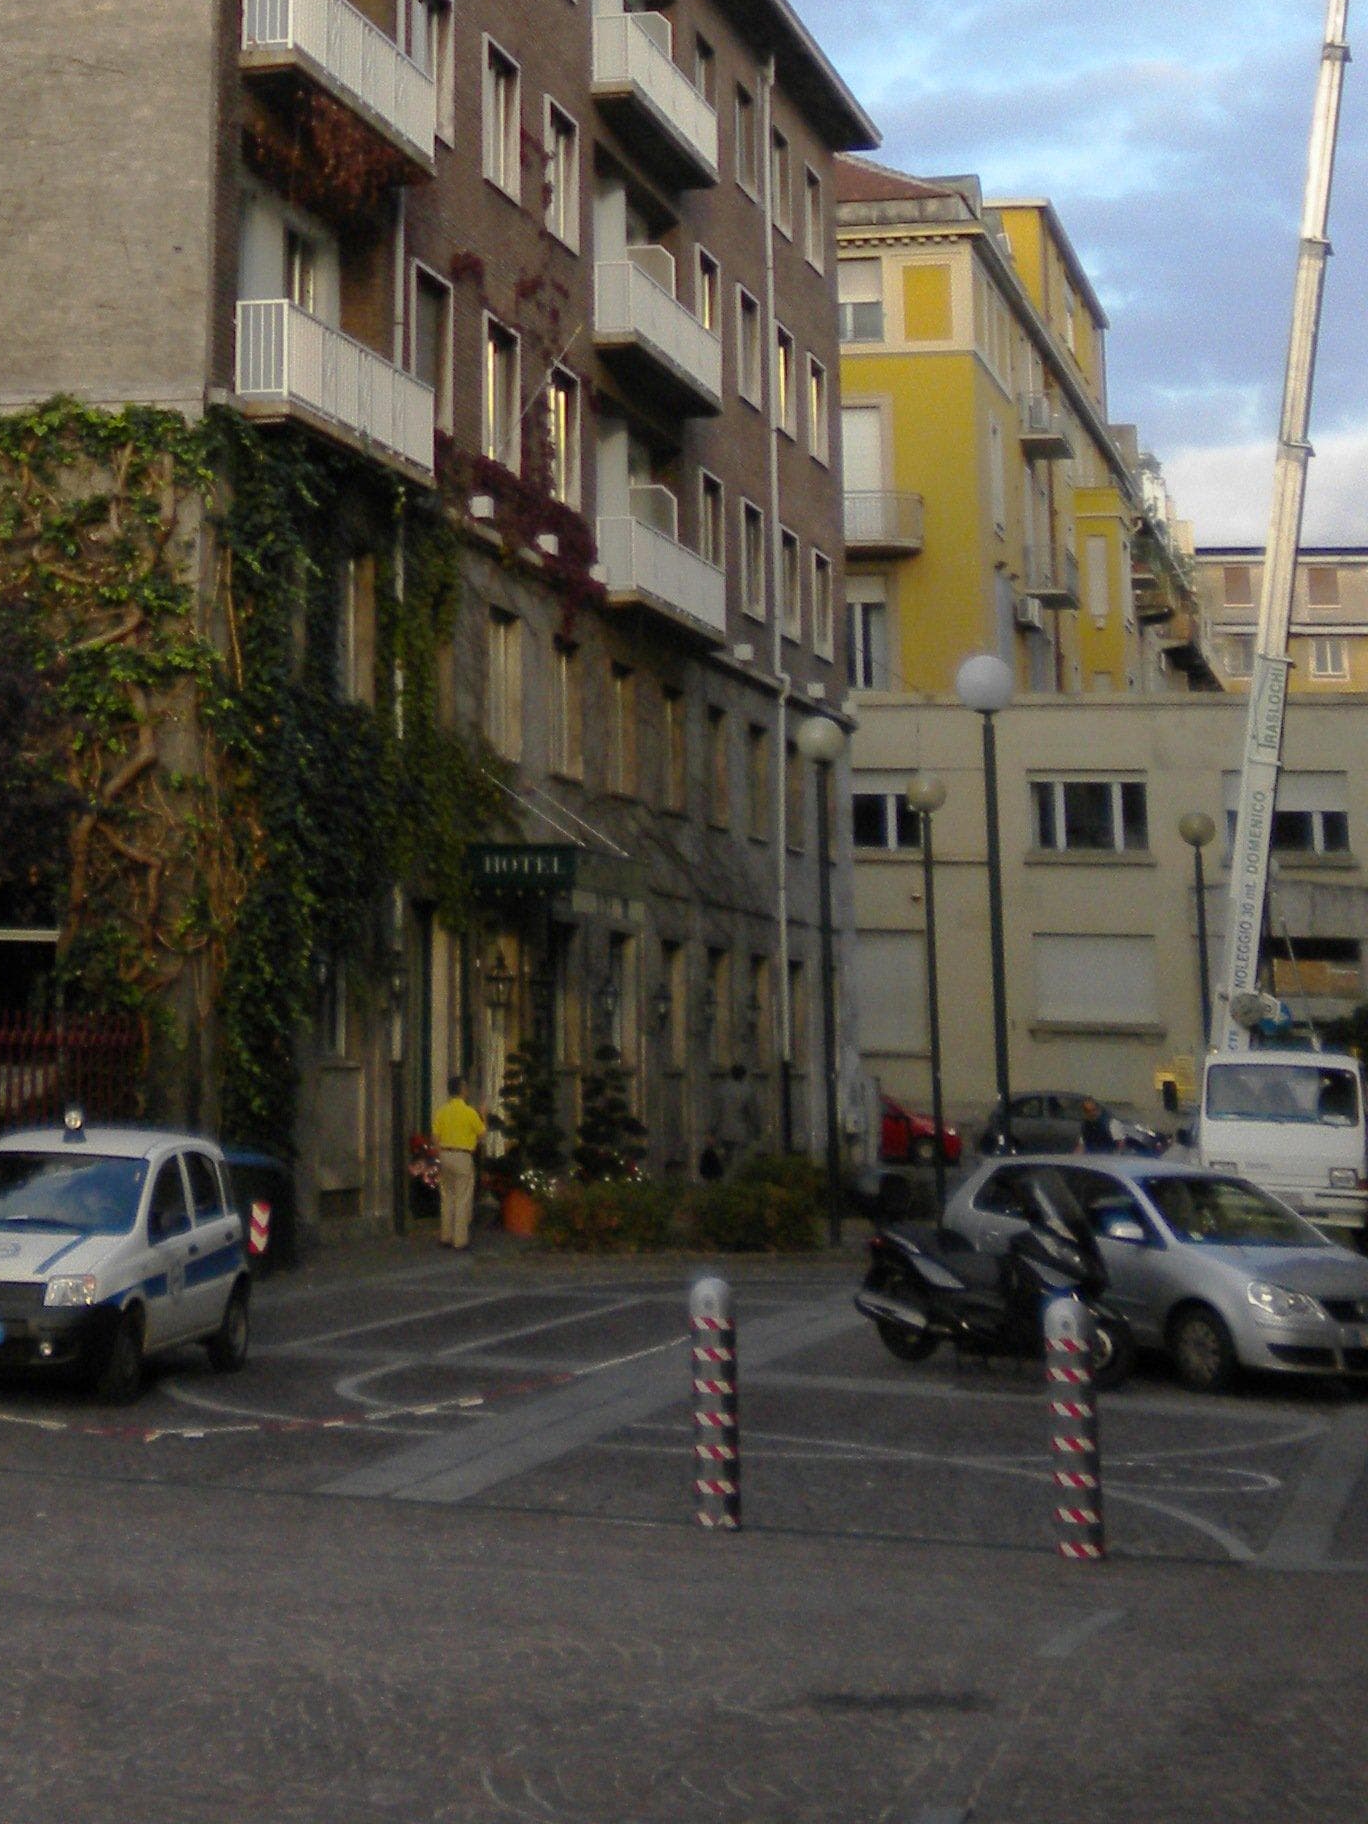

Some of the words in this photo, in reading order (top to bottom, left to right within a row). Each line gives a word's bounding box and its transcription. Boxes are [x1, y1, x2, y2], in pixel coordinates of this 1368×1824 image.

[1257, 667, 1284, 749] TRASLOCHI
[484, 856, 561, 874] HOTEL
[1245, 791, 1265, 874] DOMENICO
[1242, 902, 1255, 917] 30
[1235, 921, 1253, 989] NOLEGGIO
